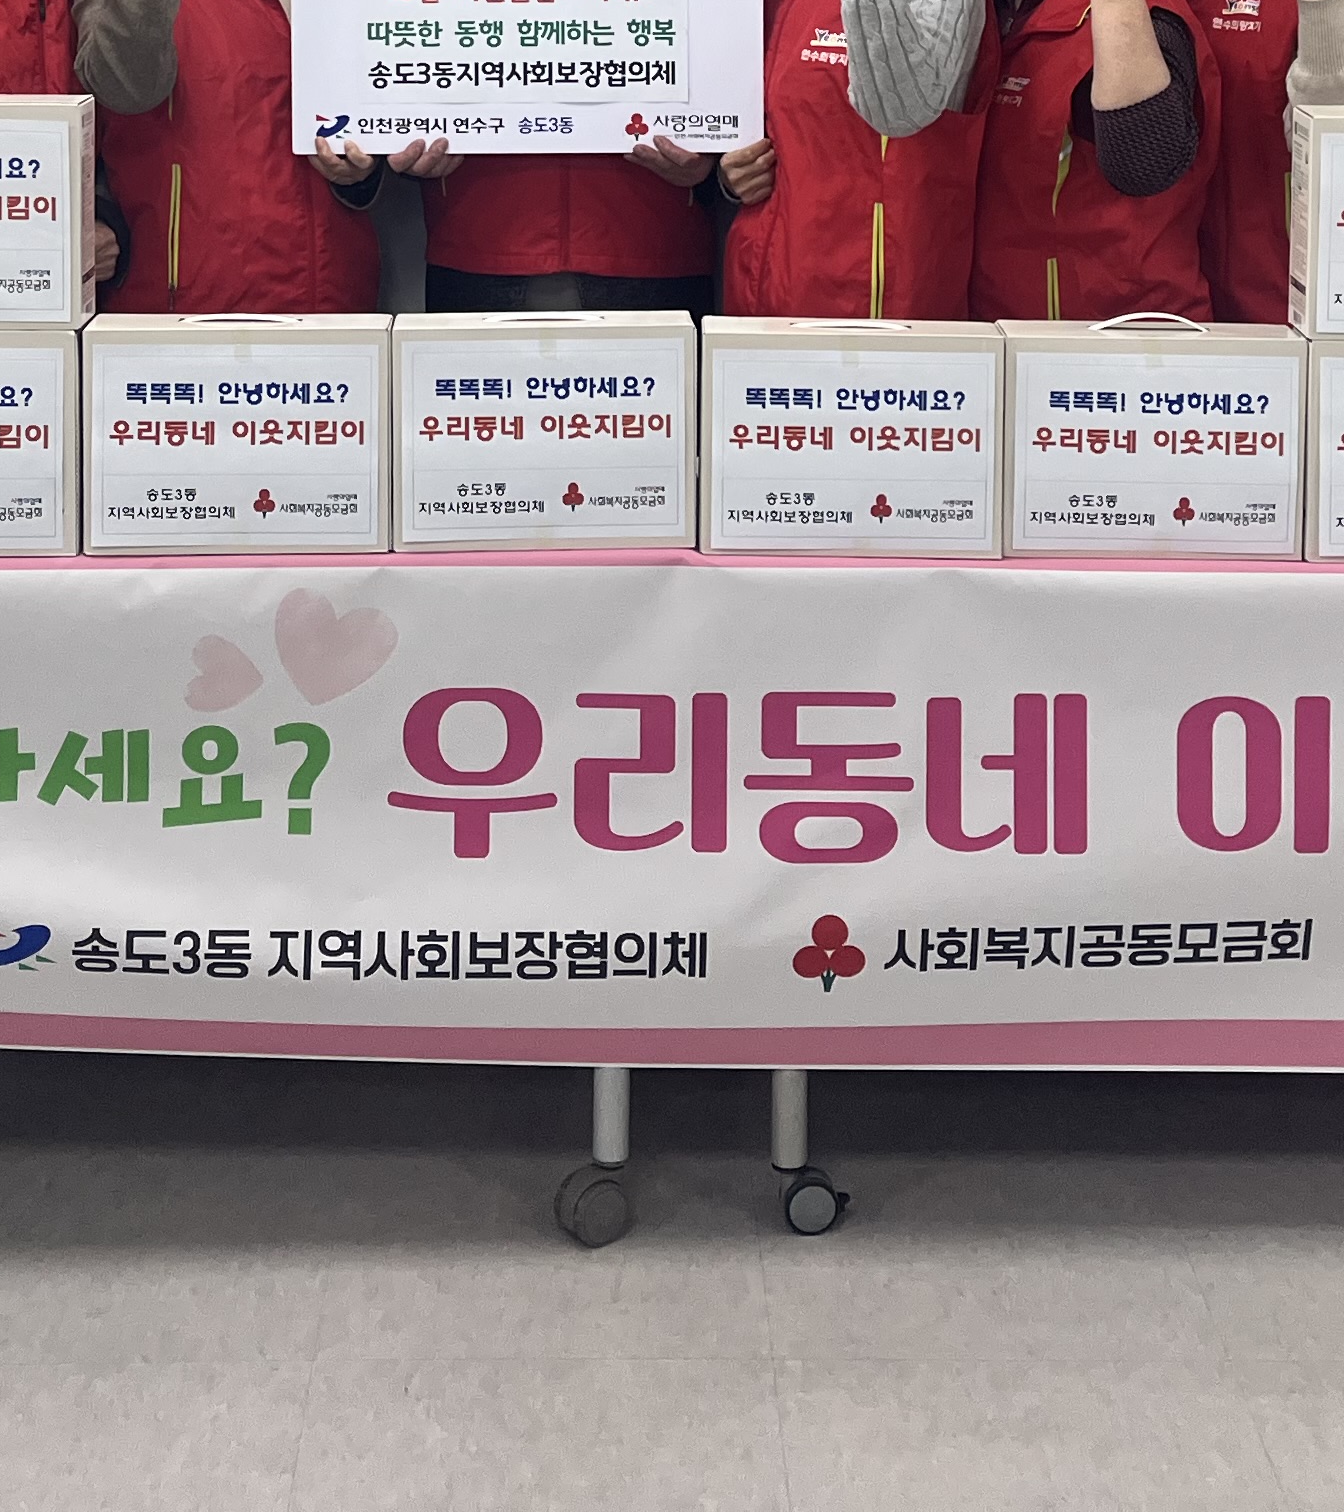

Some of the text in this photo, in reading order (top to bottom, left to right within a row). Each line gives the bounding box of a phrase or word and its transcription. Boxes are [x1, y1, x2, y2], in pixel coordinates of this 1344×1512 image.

[366, 18, 677, 49] 따뜻한 동행 함께하는 행복
[357, 116, 575, 135] 인천광역시 연수구 송도3동
[652, 114, 739, 133] 사랑의열매
[125, 381, 349, 406] 똑똑똑! 안녕하세요?
[434, 375, 656, 401] 똑똑똑! 안녕하세요?
[745, 387, 966, 412] 똑똑똑! 안녕하세요?
[1048, 390, 1270, 416] 똑똑똑! 안녕하세요?
[108, 418, 365, 448] 우리동네 이웃지킴이
[418, 413, 672, 443] 우리동네 이웃지킴이
[728, 423, 981, 453] 우리동네 이웃지킴이
[1031, 426, 1285, 457] 우리동네 이웃지킴이
[146, 487, 197, 502] 송도3동
[456, 482, 507, 498] 송도3동
[765, 491, 816, 507] 송도3동
[1067, 494, 1118, 509] 송도3동
[107, 505, 236, 521] 지역사회보장협의체
[418, 500, 545, 516] 지역사회보장협의체
[727, 509, 853, 525] 지역사회보장협의체
[1030, 510, 1156, 527] 지역사회보장협의체
[386, 686, 1089, 865] 우리동네
[70, 926, 709, 983] 송도3동 지역사회보장협의체
[882, 917, 1315, 974] 사회복지공동모금회
